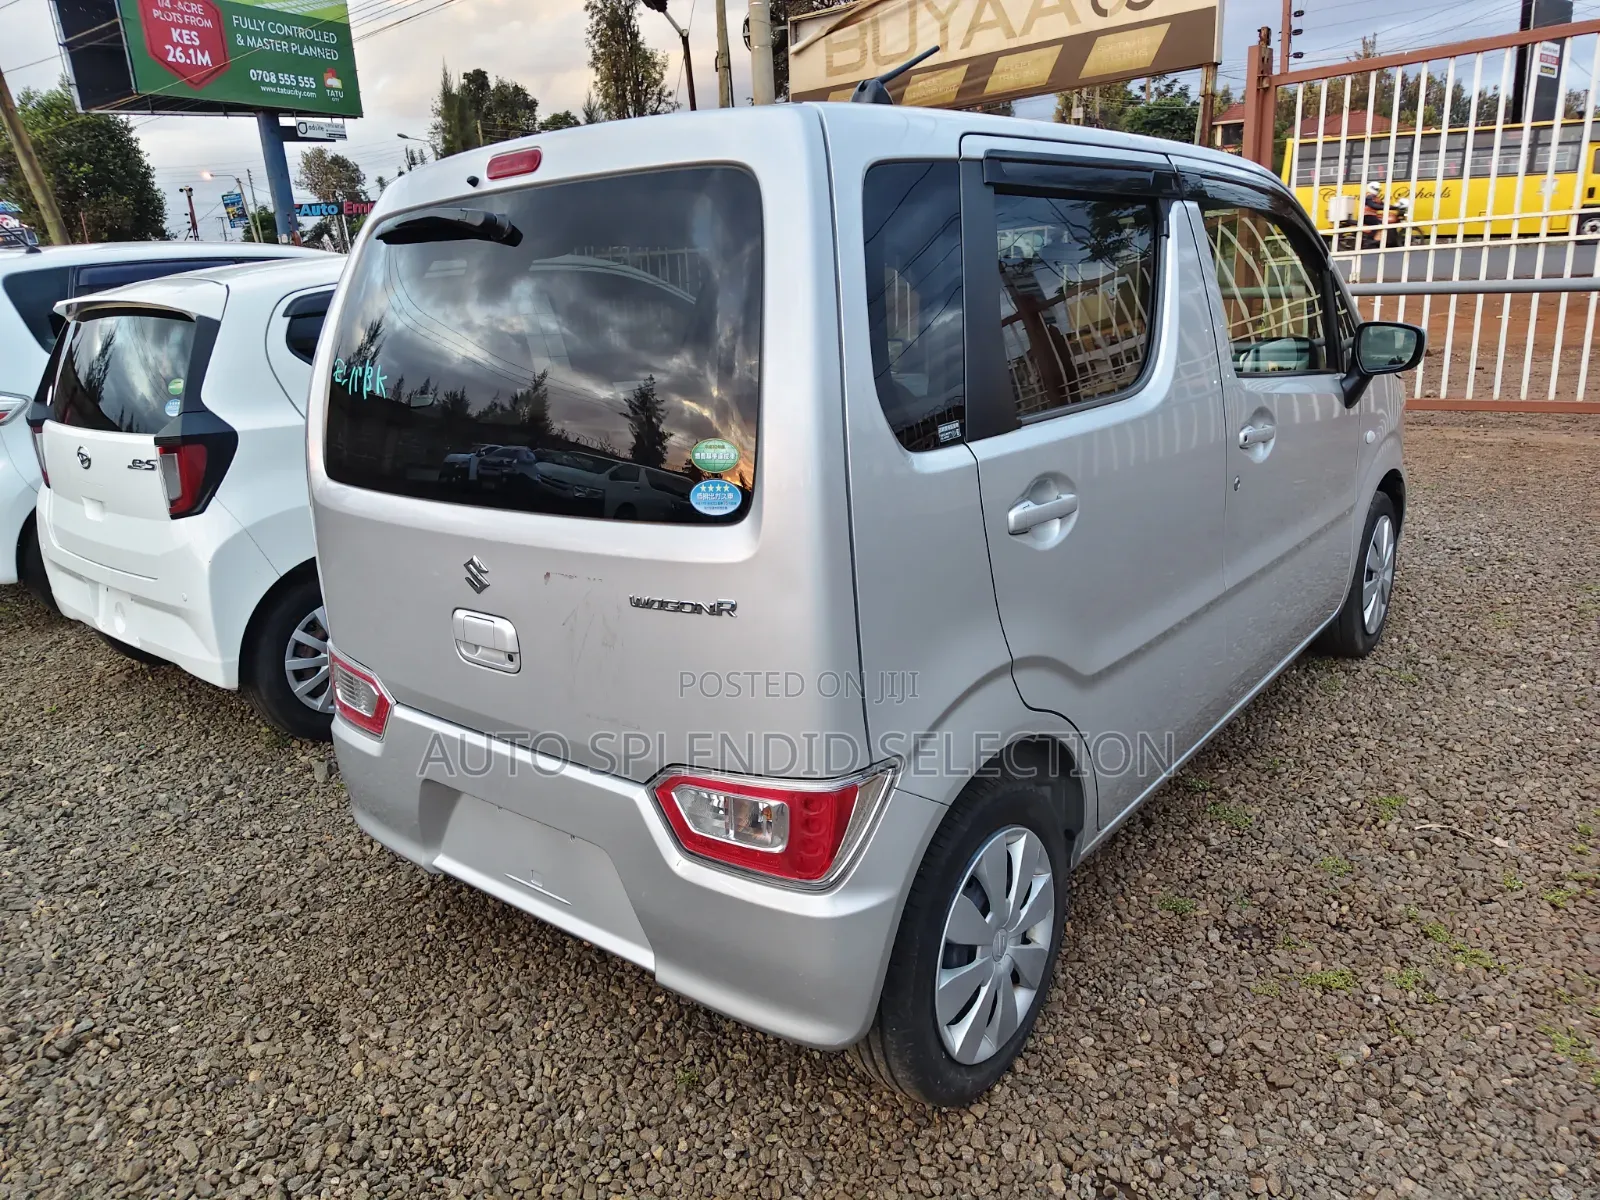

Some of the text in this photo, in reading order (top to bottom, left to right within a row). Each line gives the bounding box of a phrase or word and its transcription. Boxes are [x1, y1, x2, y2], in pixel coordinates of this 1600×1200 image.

[152, 8, 213, 28] PLOTS FROM
[170, 27, 200, 46] KES
[232, 15, 337, 44] FULLY CONTROLLED
[164, 44, 213, 67] 26.1M
[236, 34, 339, 60] & MASTER PLANNED
[249, 69, 316, 89] 0708 555 555
[260, 85, 317, 99] www.tatucity.com
[326, 89, 344, 98] TATU
[1393, 186, 1452, 200] Shools
